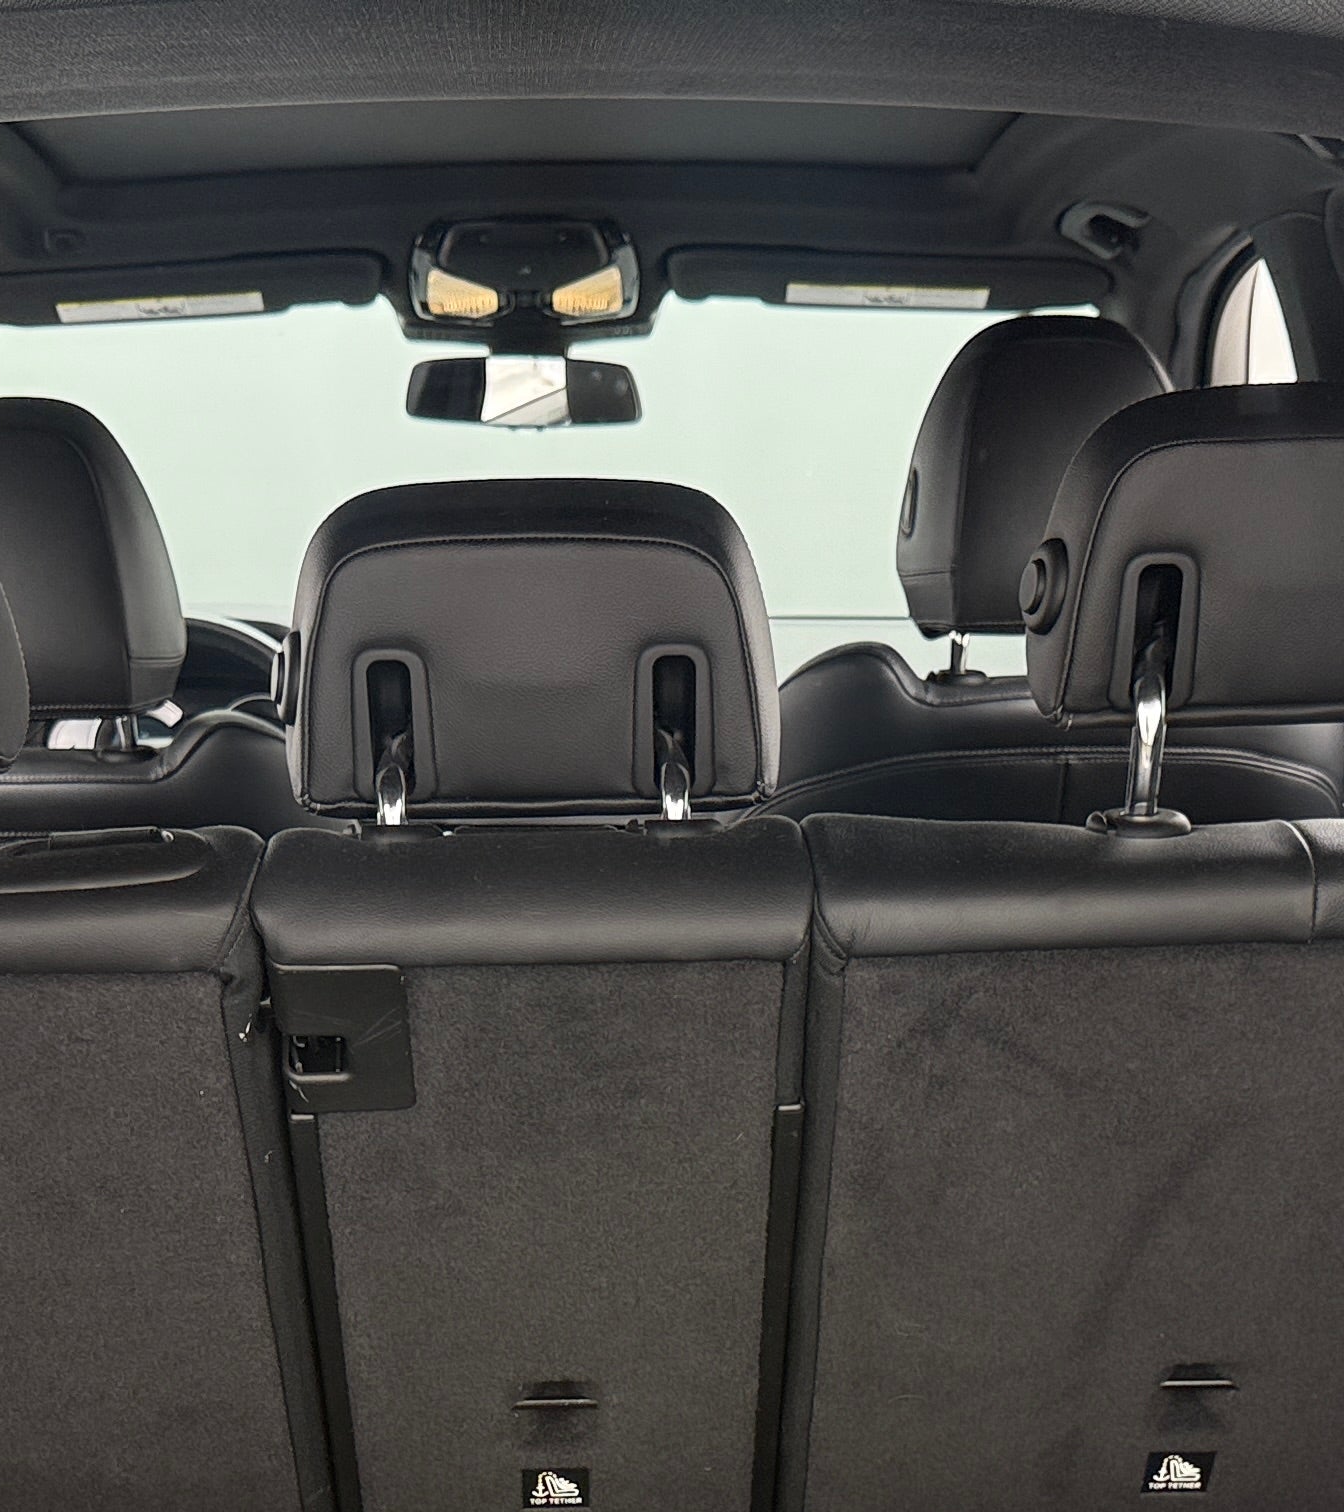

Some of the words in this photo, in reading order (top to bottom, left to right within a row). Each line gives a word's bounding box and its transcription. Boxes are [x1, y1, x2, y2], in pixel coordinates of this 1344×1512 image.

[1148, 1482, 1167, 1490] TOP
[1168, 1481, 1202, 1490] TETHER
[529, 1498, 547, 1506] TOP
[549, 1497, 583, 1505] TETHER
